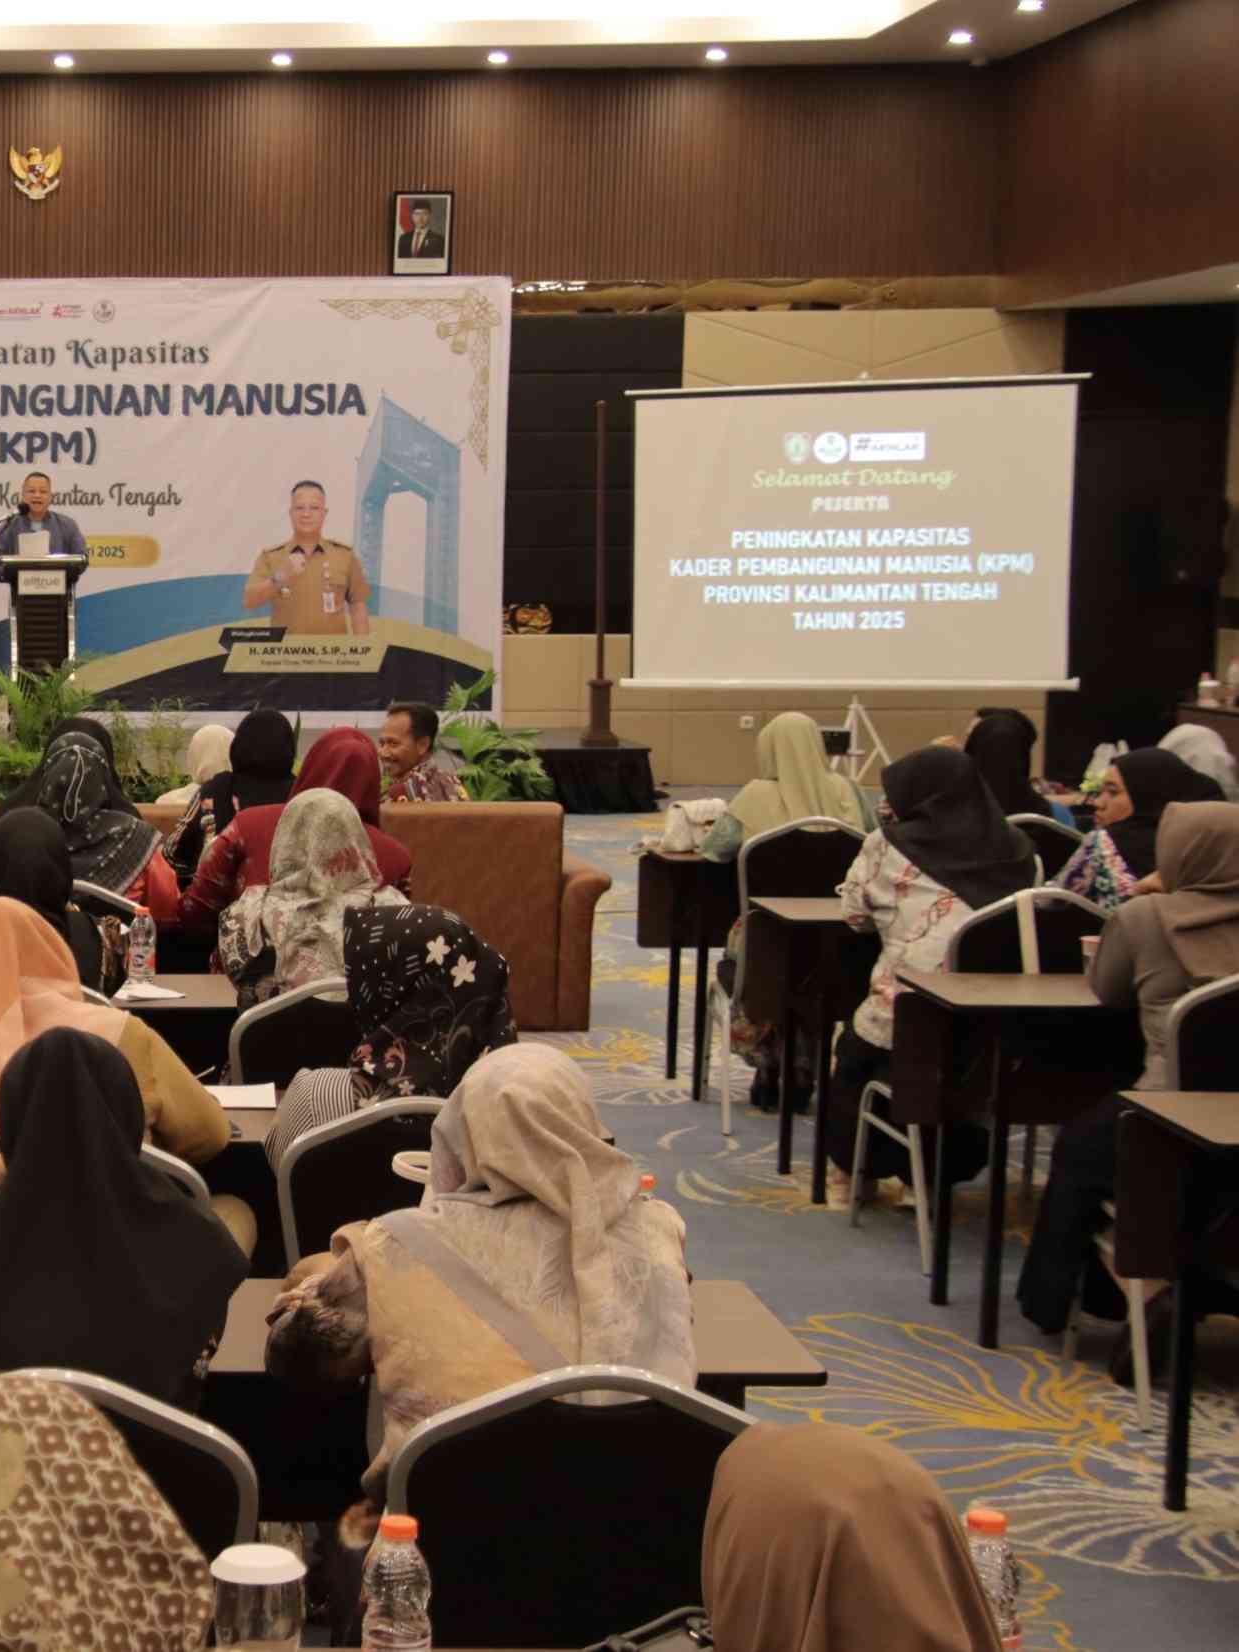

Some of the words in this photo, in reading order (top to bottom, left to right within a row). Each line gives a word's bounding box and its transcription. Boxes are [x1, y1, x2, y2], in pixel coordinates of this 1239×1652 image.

[66, 339, 210, 370] Kapasitas
[181, 383, 367, 417] MANUSIA
[752, 468, 855, 489] Selamat
[858, 466, 957, 490] Datang
[109, 483, 182, 516] Tengah
[731, 529, 862, 548] PENINGKATAN
[866, 528, 971, 547] KAPASITAS
[97, 545, 125, 559] 2025
[669, 557, 733, 577] KADER
[737, 556, 882, 576] PEMBANGUNAN
[886, 554, 972, 574] MANUSIA
[977, 552, 1034, 576] (KPM)
[704, 584, 790, 603] PROVINSI
[794, 583, 917, 602] KALIMANTAN
[921, 582, 999, 601] TENGAH
[792, 612, 855, 631] TAHUN
[859, 611, 906, 630] 2025
[249, 646, 259, 656] H.
[262, 646, 319, 657] ARYAWAN,
